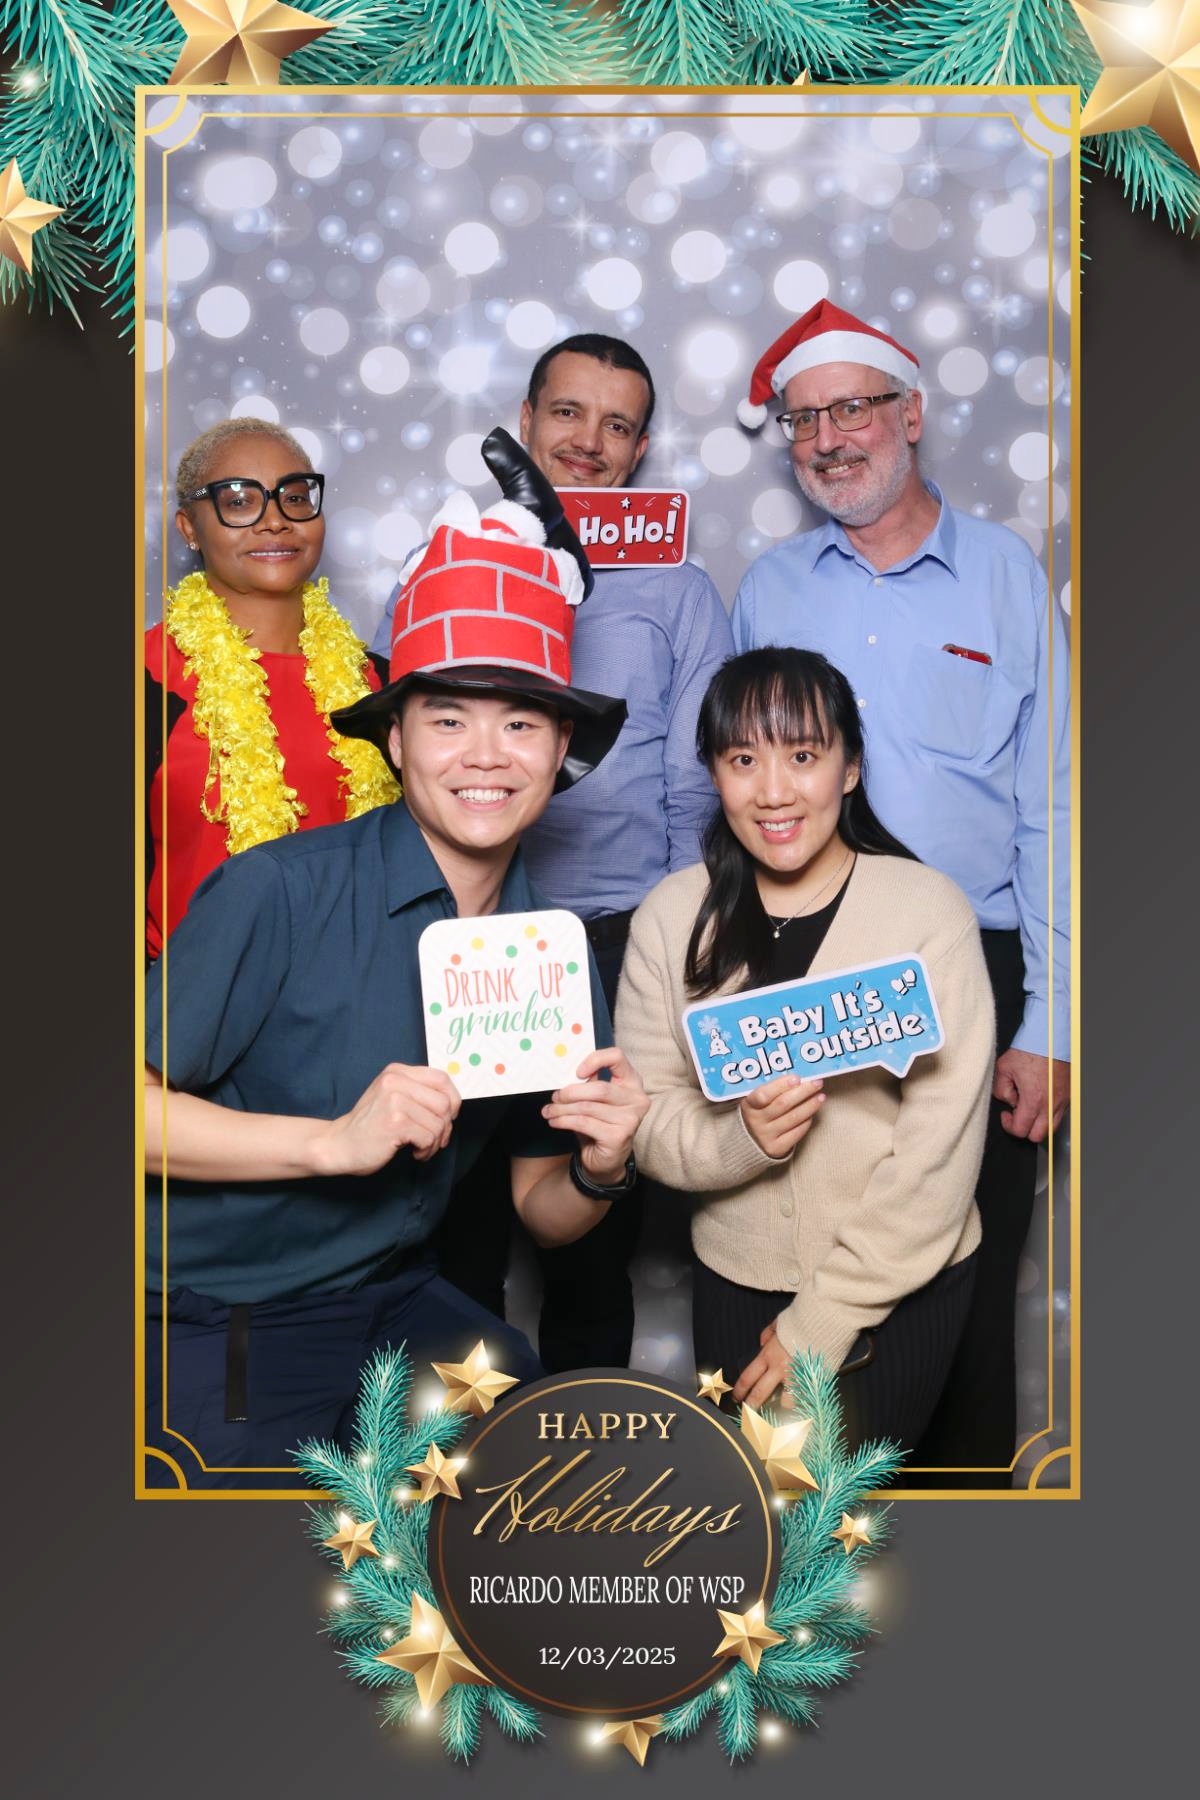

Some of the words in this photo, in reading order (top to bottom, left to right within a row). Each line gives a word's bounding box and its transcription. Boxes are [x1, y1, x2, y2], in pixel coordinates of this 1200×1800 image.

[444, 966, 519, 1007] DRINK
[538, 962, 564, 999] UP
[738, 1004, 824, 1047] Baby
[830, 980, 884, 1022] It's
[447, 990, 565, 1055] grinches
[721, 1041, 793, 1084] cold
[800, 1011, 925, 1063] outside
